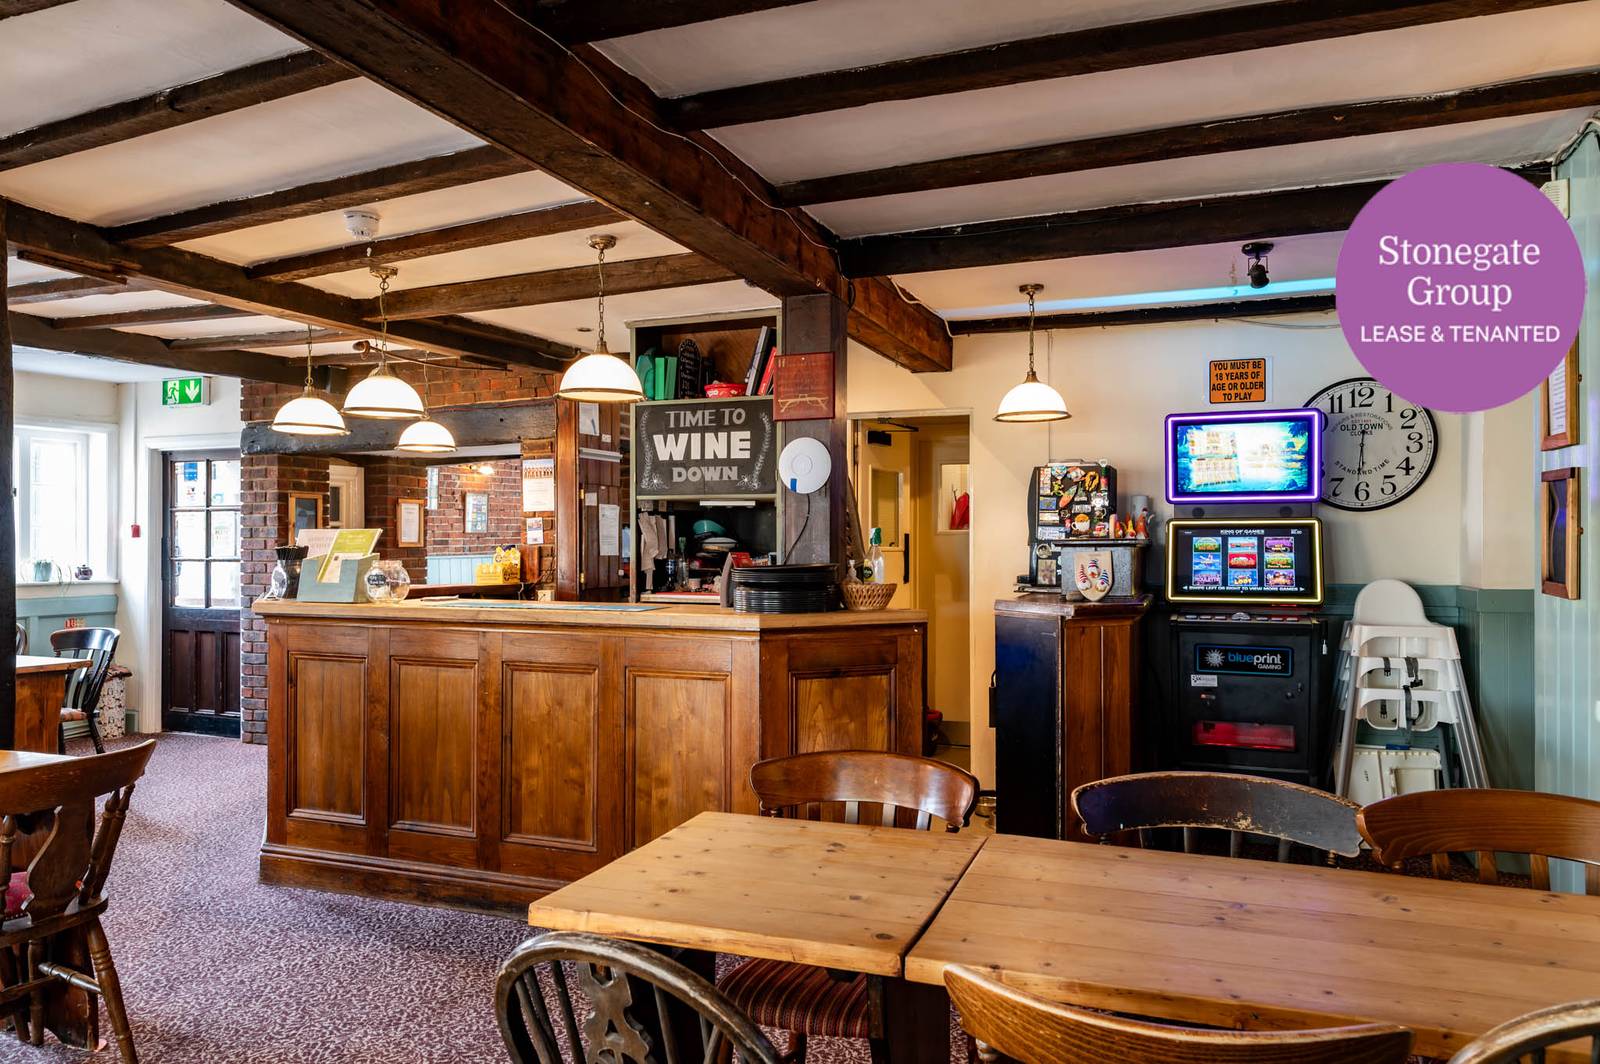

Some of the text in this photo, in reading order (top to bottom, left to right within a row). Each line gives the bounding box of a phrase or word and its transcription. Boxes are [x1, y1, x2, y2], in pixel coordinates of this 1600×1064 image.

[1213, 360, 1262, 371] YOU MUST BE
[1215, 371, 1261, 381] 18 YEARS OF
[1211, 381, 1264, 392] AGE OR OLDER
[1223, 392, 1252, 401] TO PLAY
[1328, 393, 1344, 414] 11
[1349, 386, 1375, 408] 12
[1384, 392, 1394, 412] 1
[665, 407, 746, 428] TIME TO
[1340, 422, 1384, 431] OLD TOWN
[1399, 408, 1417, 429] 2
[652, 431, 751, 461] WINE
[1406, 432, 1424, 453] 3
[671, 465, 738, 483] DOWN
[1372, 458, 1390, 472] TIME
[1395, 456, 1416, 476] 4
[1330, 477, 1345, 497] 7
[1354, 481, 1370, 501] 6
[1380, 475, 1397, 496] 5
[1227, 652, 1282, 666] blueprint
